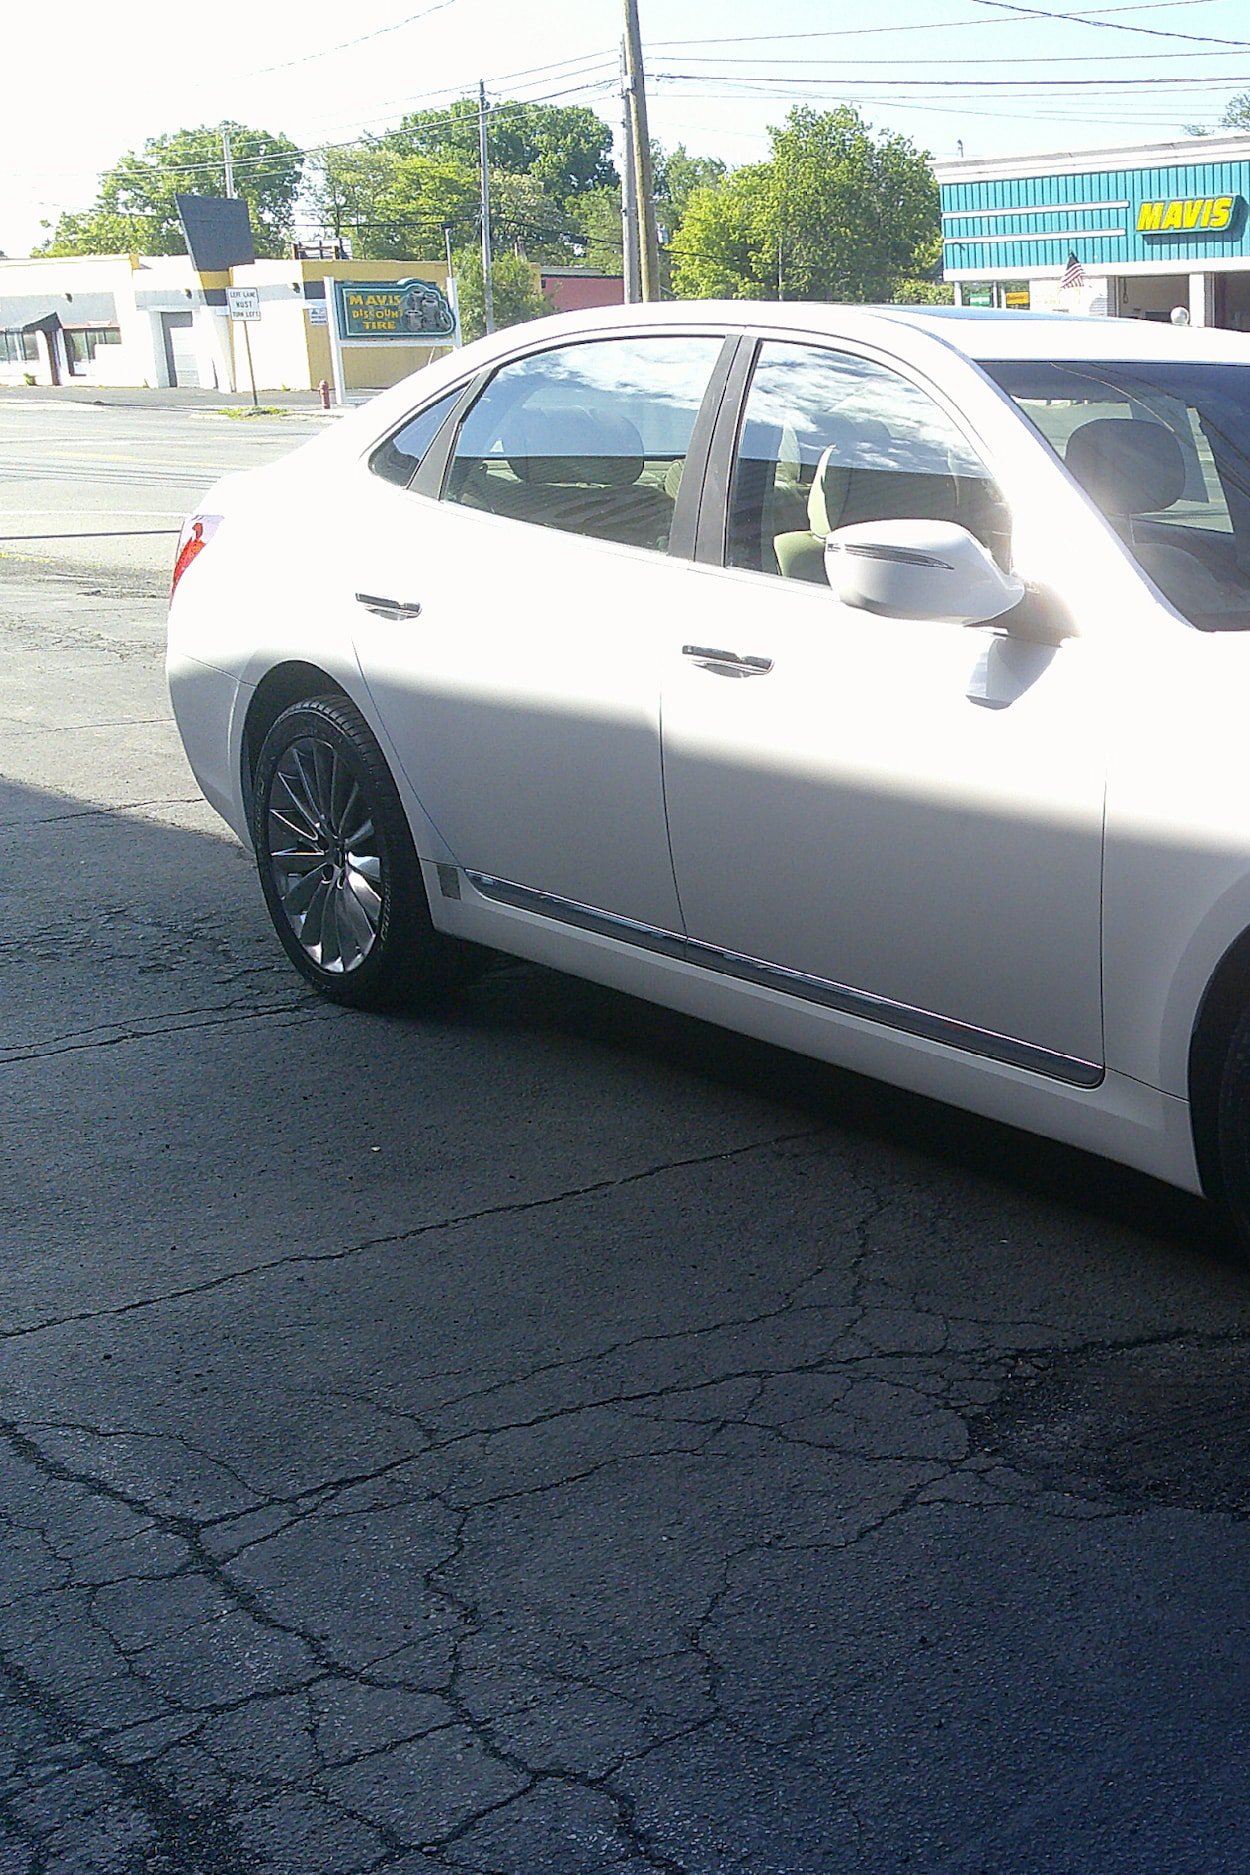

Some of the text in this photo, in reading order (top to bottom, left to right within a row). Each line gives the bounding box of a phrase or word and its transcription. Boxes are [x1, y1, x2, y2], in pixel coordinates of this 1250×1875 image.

[1136, 197, 1233, 231] MAVIS
[349, 295, 401, 306] MAVIS
[352, 309, 403, 319] DISCOUNT
[362, 321, 396, 330] TIRE
